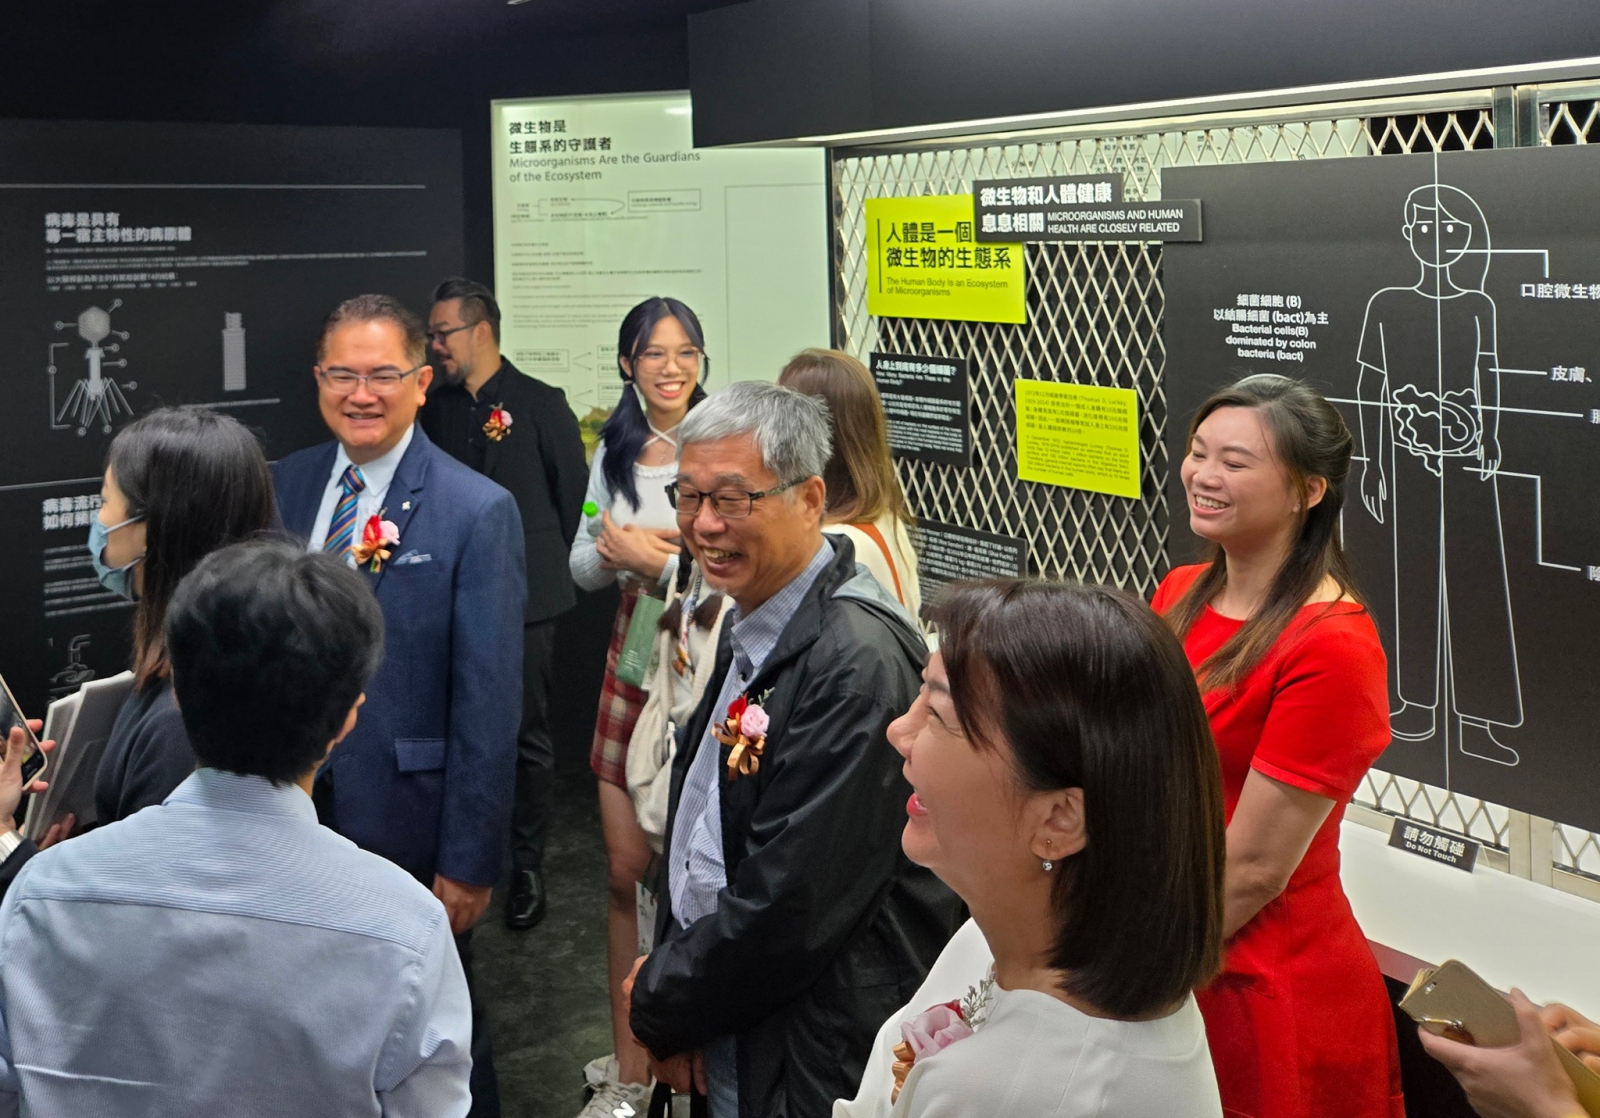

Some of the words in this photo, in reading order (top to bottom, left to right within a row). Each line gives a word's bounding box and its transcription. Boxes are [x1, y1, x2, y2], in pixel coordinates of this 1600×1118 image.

[509, 120, 567, 135] 微生物是
[509, 137, 612, 154] 生態系的守護者
[510, 155, 596, 169] Microorganisms
[598, 155, 618, 165] Are
[621, 154, 640, 164] the
[643, 151, 701, 163] Guardians
[510, 172, 521, 182] of
[524, 171, 541, 182] the
[545, 170, 602, 182] Ecosystem
[980, 182, 1112, 206] 微生物和人體健康
[982, 212, 1044, 232] 息息相關
[1047, 210, 1125, 222] MICROORGANISMS
[1127, 210, 1146, 220] AND
[1148, 208, 1184, 219] HUMAN
[886, 222, 972, 243] 人體是一個
[1048, 224, 1078, 234] HEALTH
[1080, 224, 1097, 234] ARE
[1098, 223, 1137, 233] CLOSELY
[1139, 222, 1180, 232] RELATED
[886, 247, 1011, 270] 微生物的生態系
[886, 276, 899, 286] The
[901, 278, 925, 286] Human
[927, 278, 945, 288] Body
[966, 279, 1008, 290] Ecosystem
[886, 286, 894, 295] of
[896, 287, 950, 297] Microorganisms
[1236, 294, 1284, 308] 細菌細胞
[1286, 296, 1302, 309] (B)
[1232, 323, 1272, 334] Bacterial
[1274, 326, 1308, 338] cells(B)
[1226, 335, 1274, 346] dominated
[1276, 338, 1288, 349] by
[1289, 339, 1316, 349] colon
[1237, 348, 1275, 359] bacteria
[1276, 350, 1304, 362] (bact)
[1404, 826, 1465, 857] 請勿觸碰
[1406, 841, 1416, 850] Do
[1418, 845, 1432, 855] Not
[1433, 850, 1456, 864] Touch
